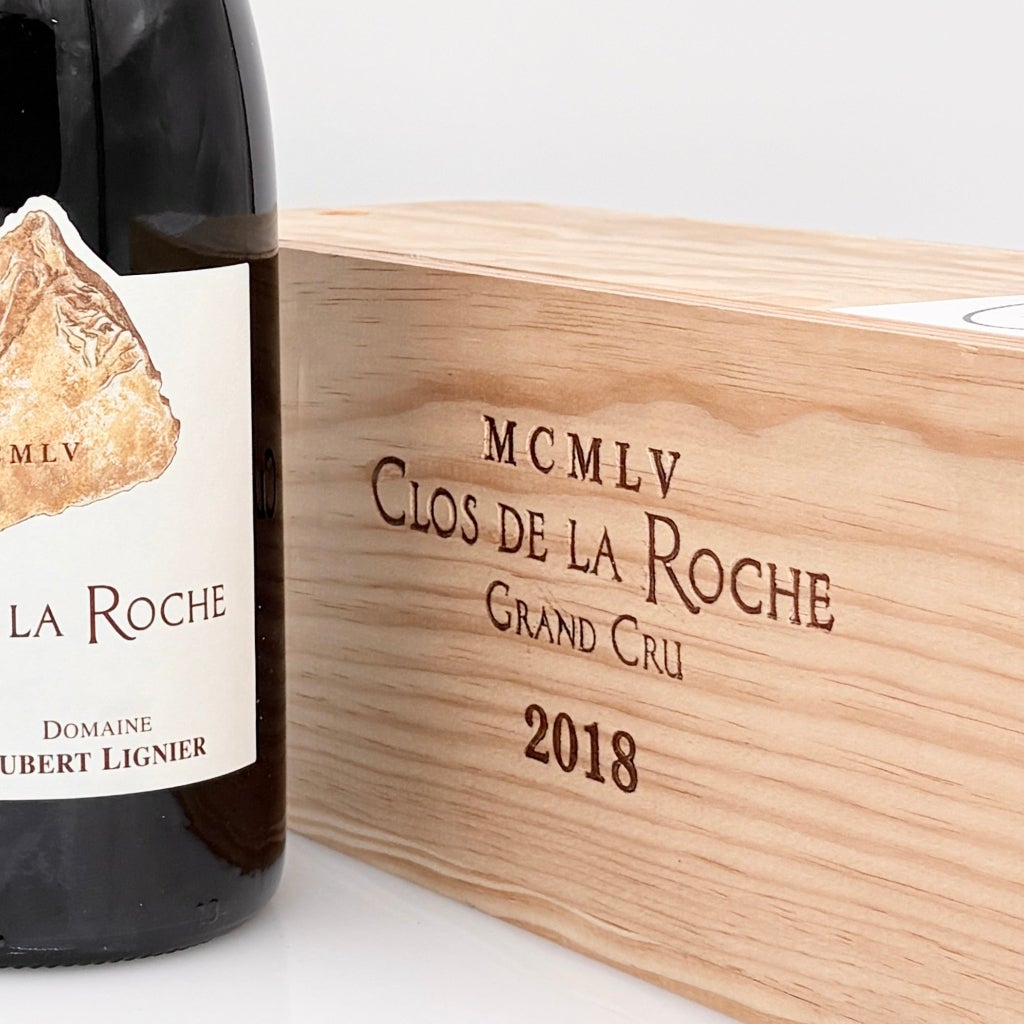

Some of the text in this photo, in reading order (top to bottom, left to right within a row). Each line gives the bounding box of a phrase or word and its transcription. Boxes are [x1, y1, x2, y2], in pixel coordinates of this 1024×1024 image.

[481, 413, 682, 499] MCMLV
[371, 455, 836, 632] CLOS DE LA ROCHE
[9, 603, 64, 638] LA
[87, 584, 227, 645] ROCHE
[485, 580, 684, 681] GRAND CRU
[42, 716, 153, 740] DOMAINE
[102, 736, 207, 771] LIGNIER
[524, 703, 639, 794] 2018
